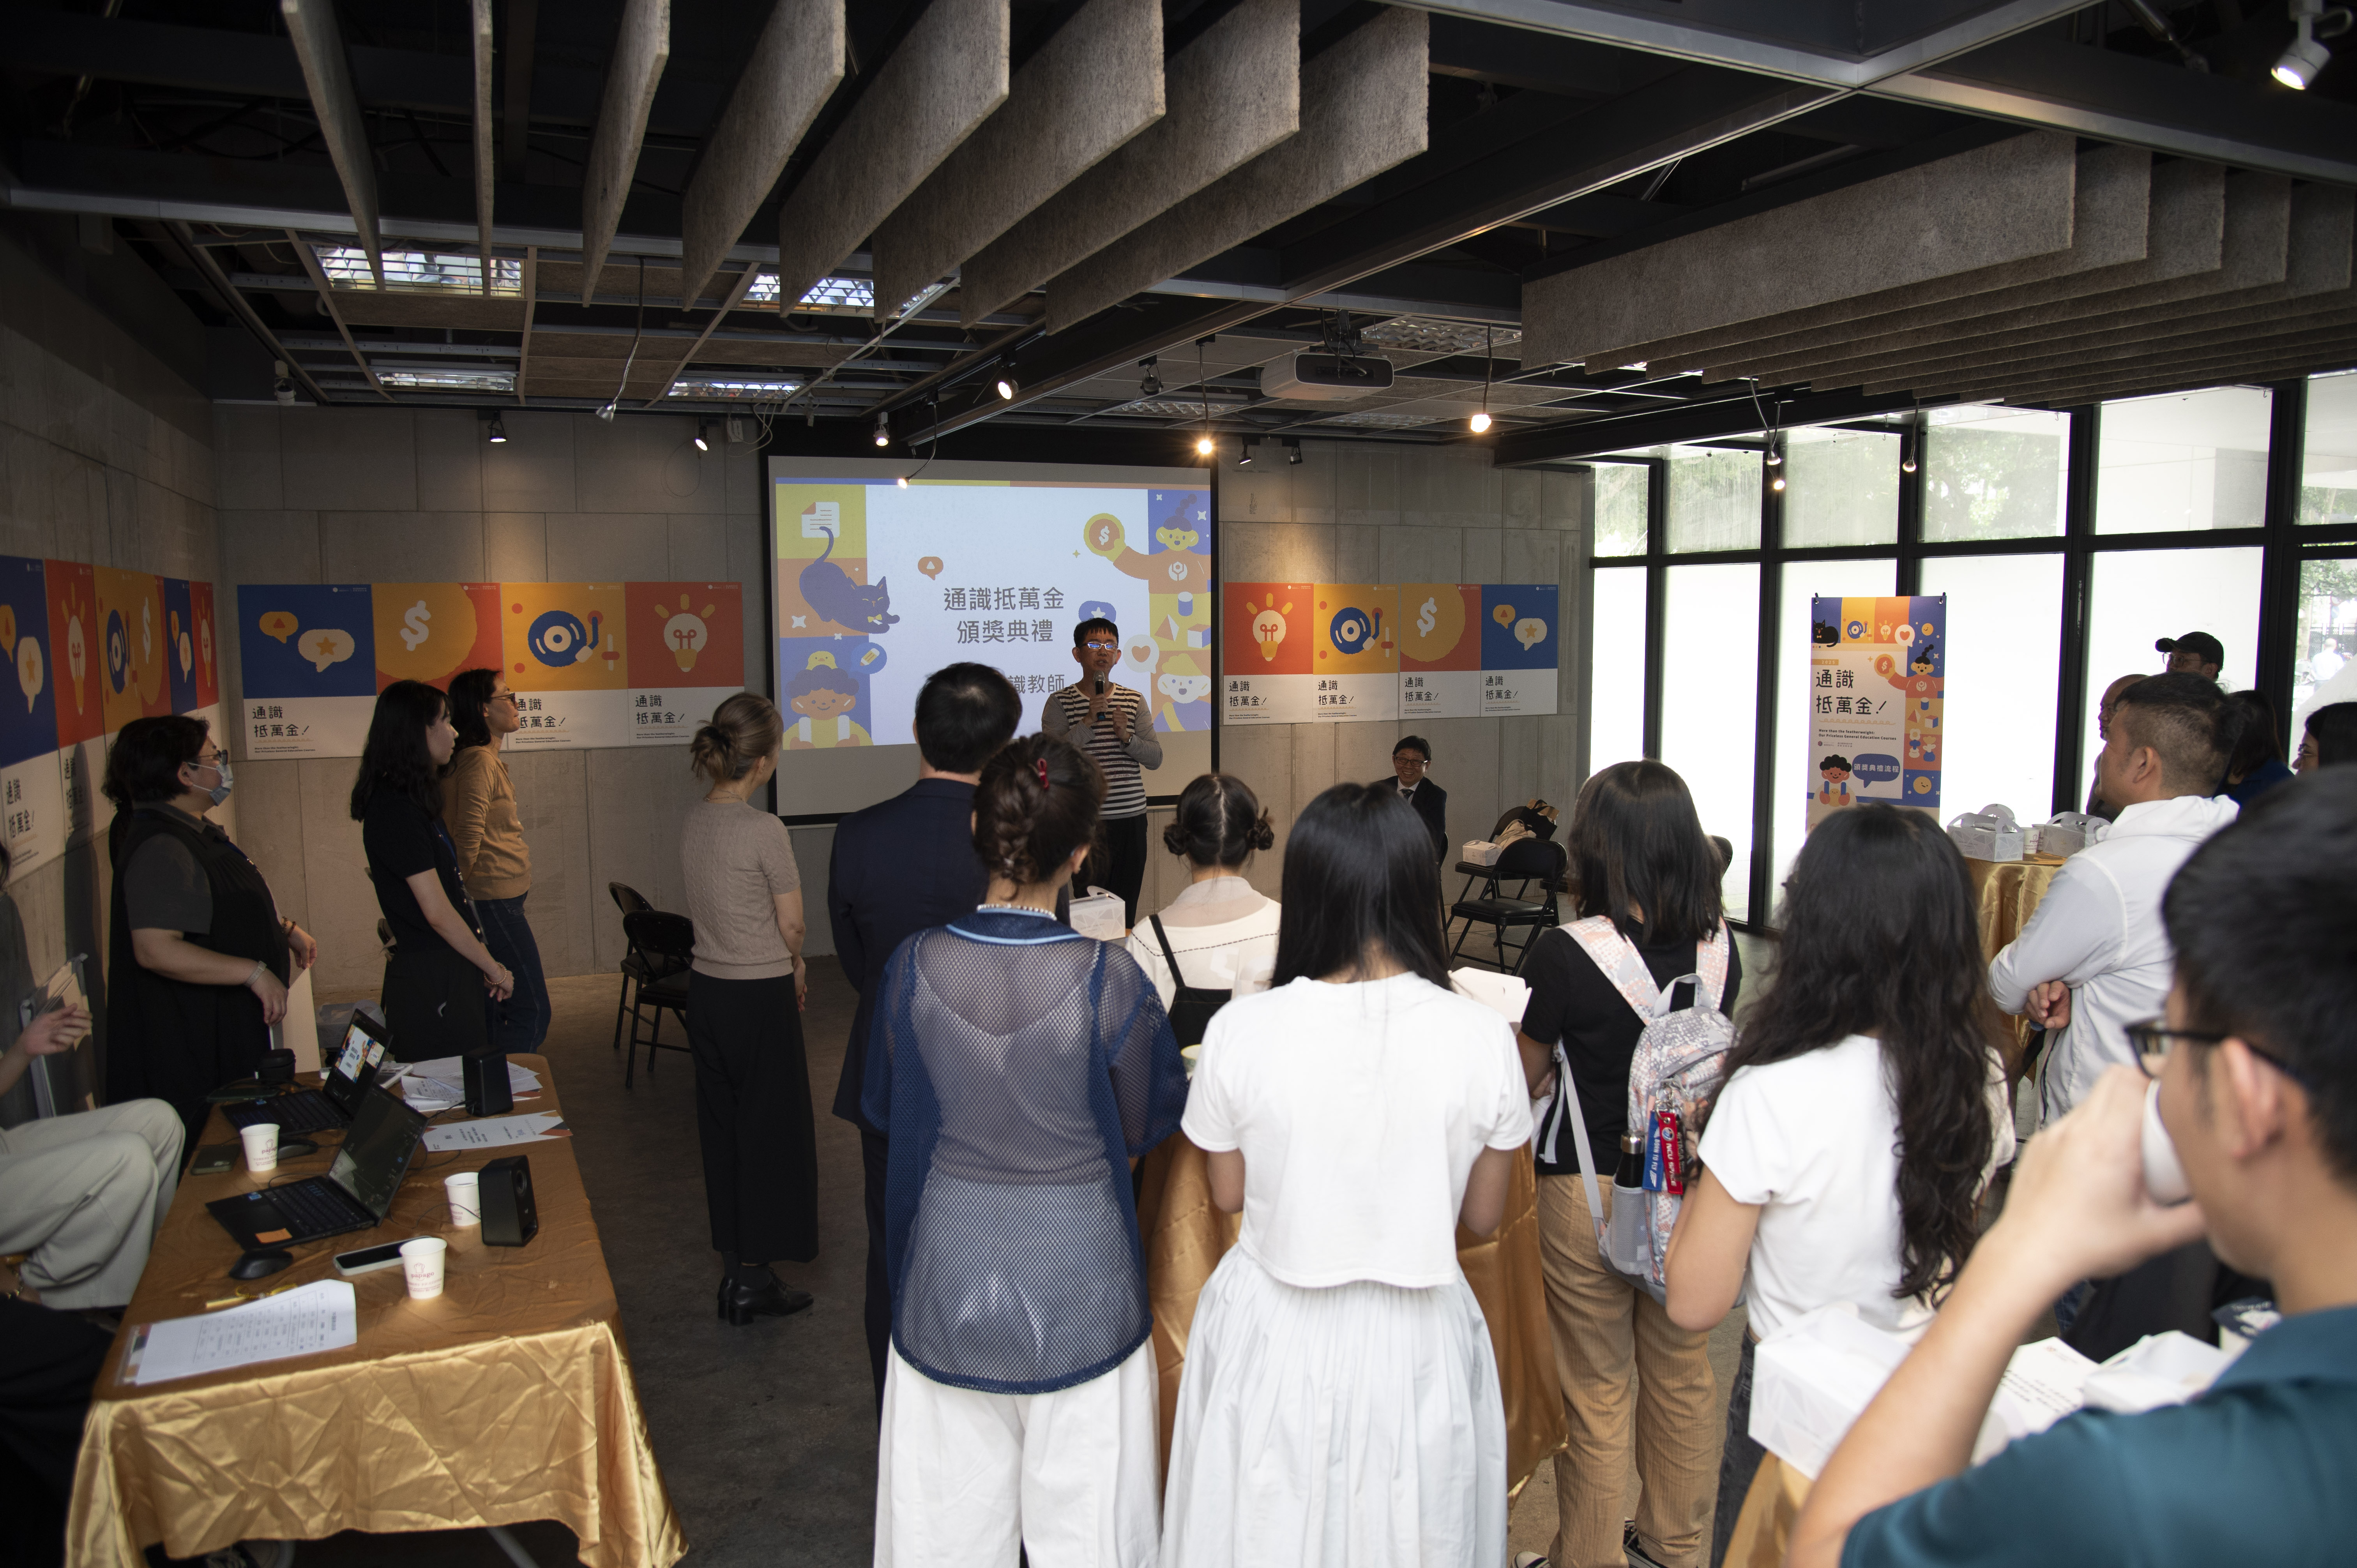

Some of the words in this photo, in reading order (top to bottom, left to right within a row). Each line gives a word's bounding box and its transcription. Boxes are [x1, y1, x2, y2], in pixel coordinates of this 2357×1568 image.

[944, 586, 1064, 611] 通識抵萬金
[957, 619, 1053, 644] 頒獎典禮
[1318, 680, 1338, 690] 通識
[1405, 677, 1423, 687] 通識
[1486, 676, 1503, 686] 通識
[1816, 669, 1854, 689] 通識
[1229, 681, 1249, 692] 通識
[635, 695, 662, 707] 通識
[1816, 695, 1887, 715] 抵萬金!
[253, 706, 283, 719] 通識
[1854, 763, 1899, 773] 頒獎典禮流程
